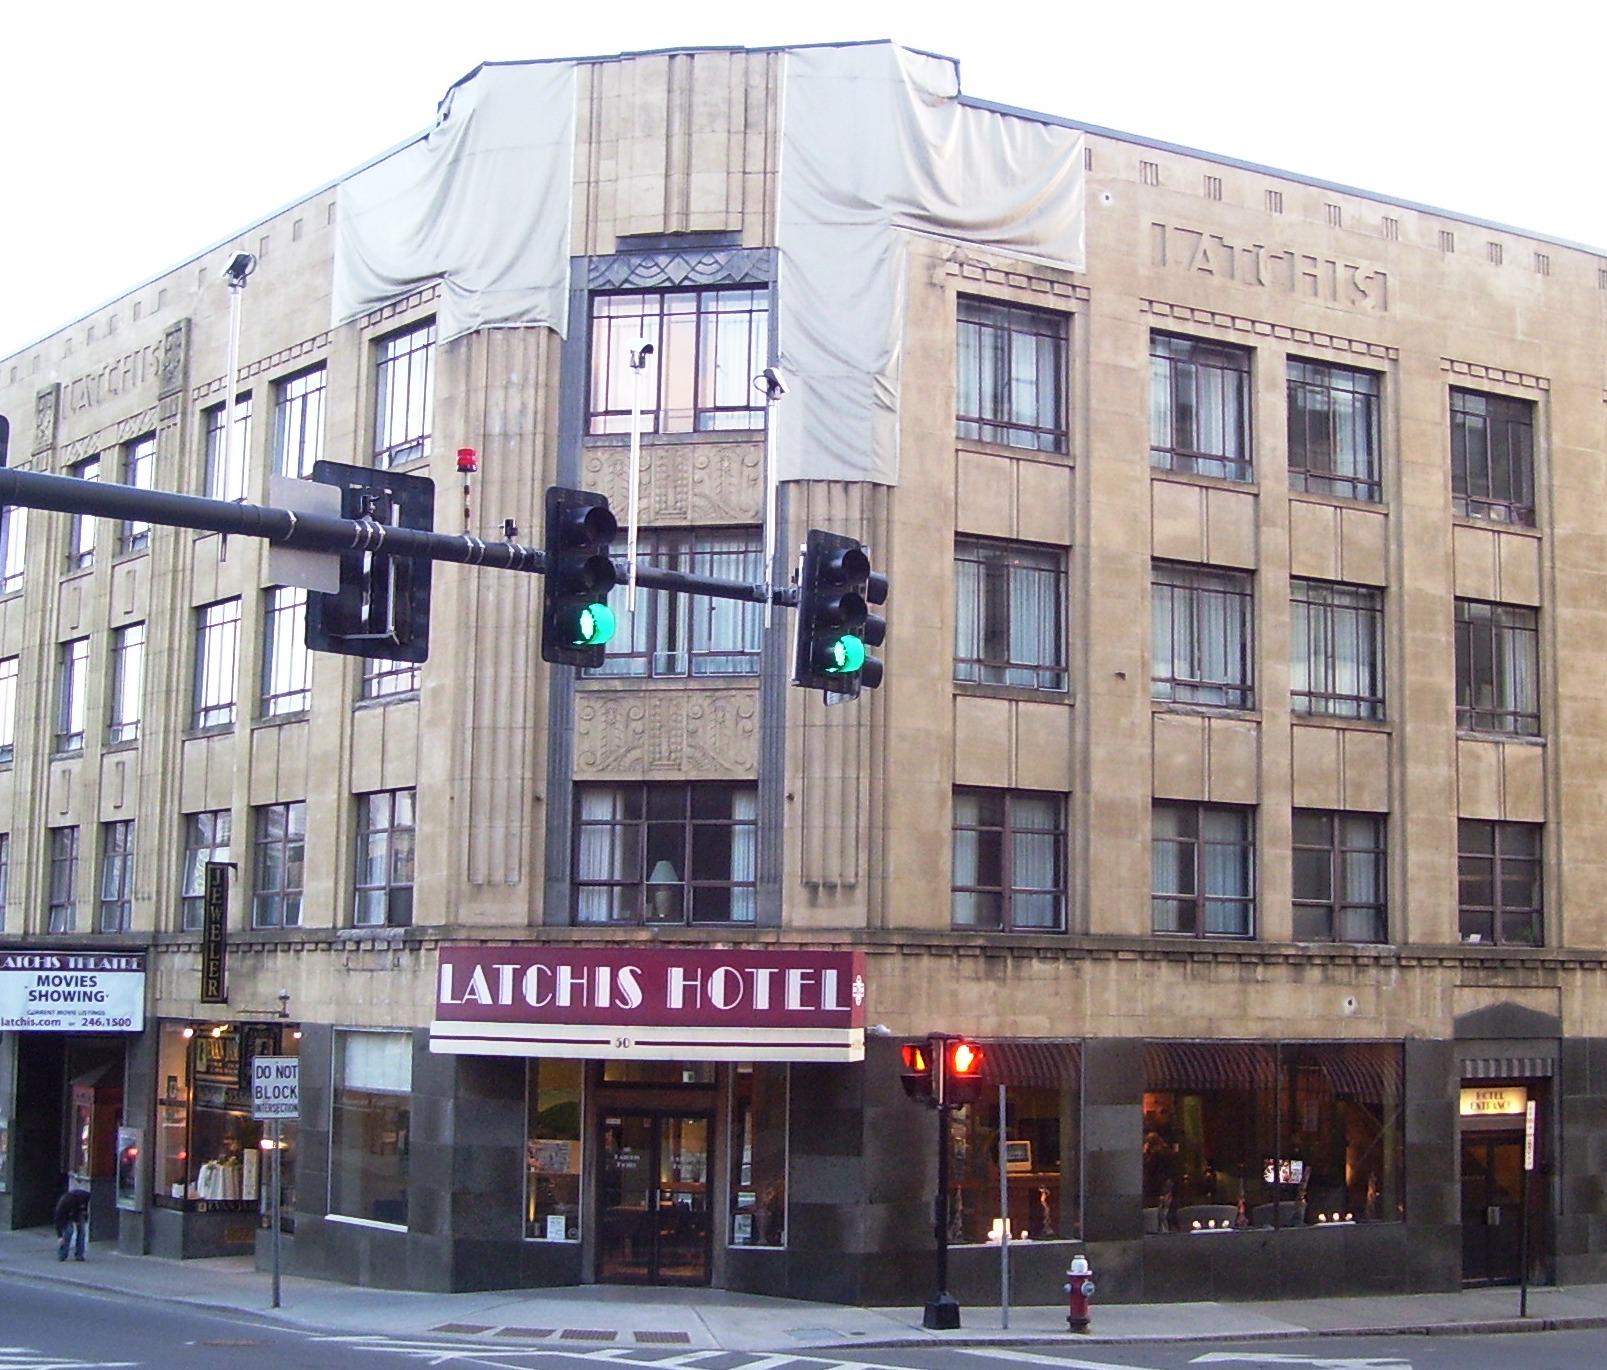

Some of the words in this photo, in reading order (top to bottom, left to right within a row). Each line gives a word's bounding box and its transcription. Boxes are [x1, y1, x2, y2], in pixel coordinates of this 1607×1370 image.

[1151, 221, 1388, 312] LATCHIS
[208, 868, 223, 997] JEWELER
[0, 955, 61, 969] ATCHIS
[67, 956, 142, 970] THEATRE
[37, 975, 98, 988] MOVIES
[440, 963, 643, 1009] LATCHIS
[666, 966, 852, 1011] HOTEL
[28, 990, 105, 1003] SHOWING
[1, 1017, 61, 1027] latchis.com
[81, 1018, 132, 1027] 246.1500
[615, 1037, 631, 1049] 50
[256, 1065, 271, 1079] DO
[276, 1065, 298, 1079] NOT
[255, 1085, 298, 1099] BLOCK
